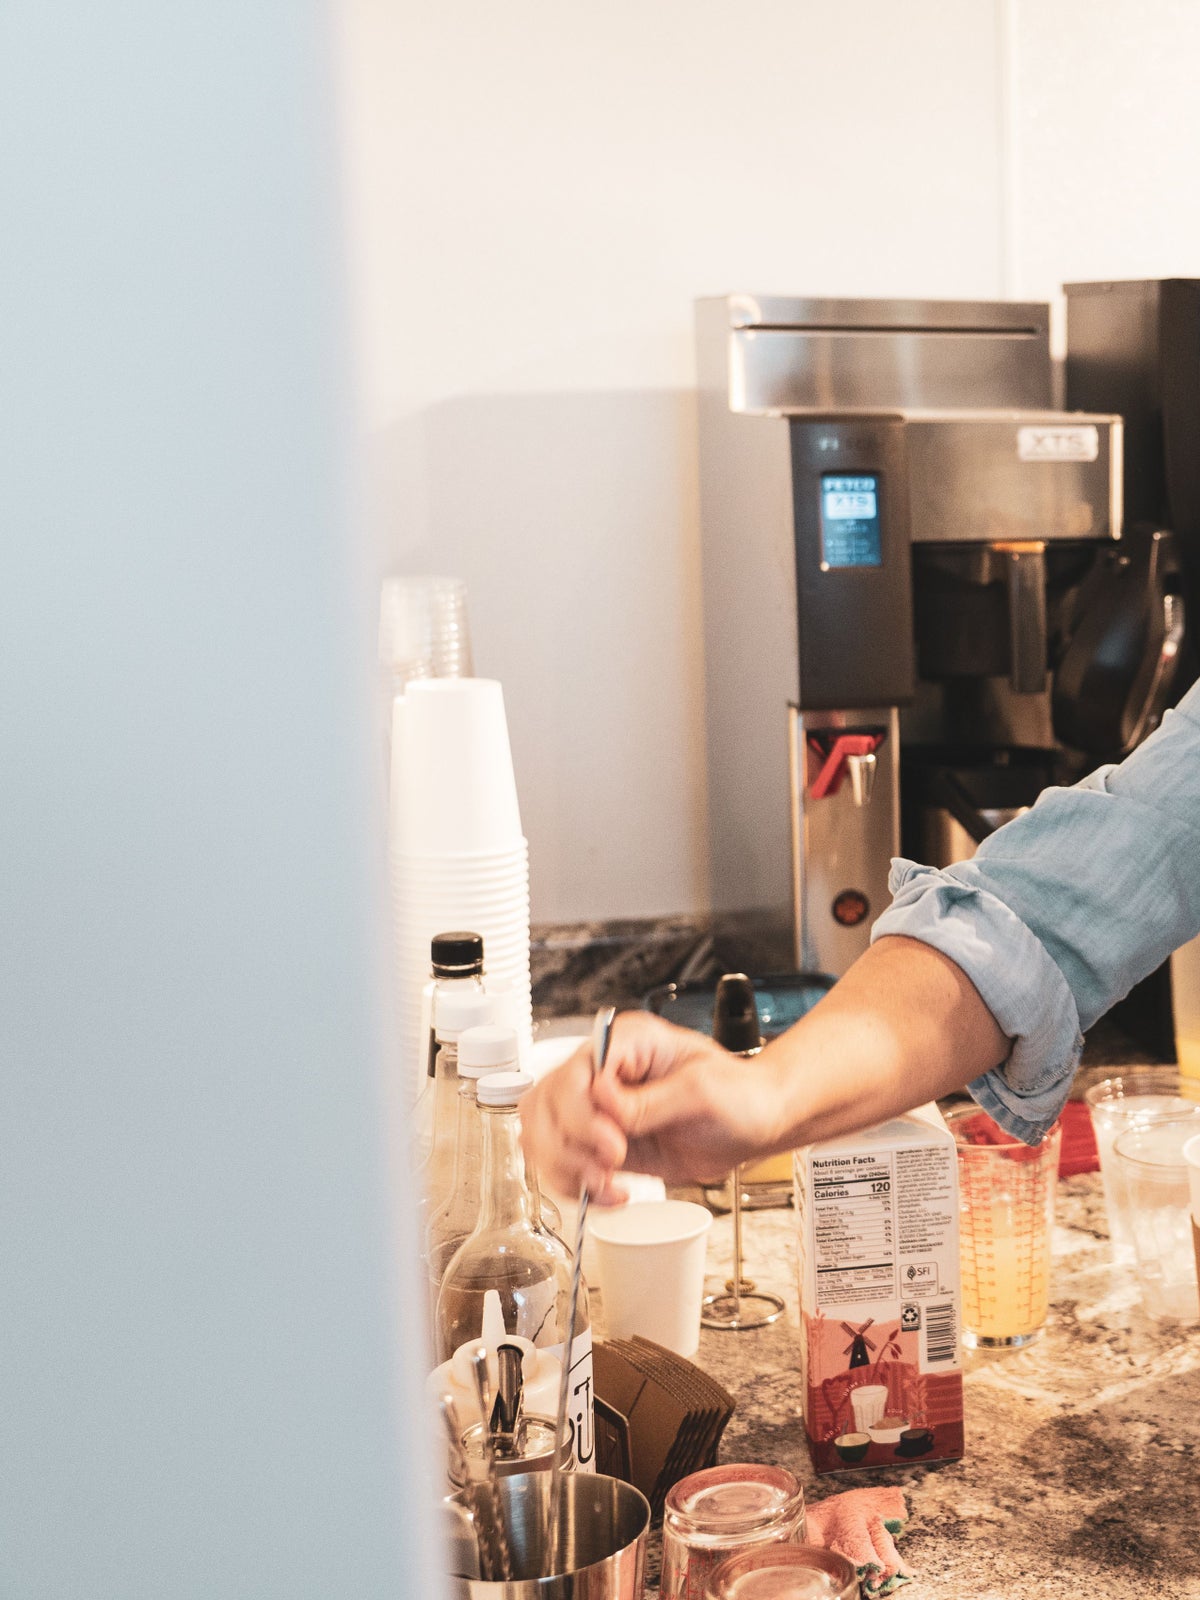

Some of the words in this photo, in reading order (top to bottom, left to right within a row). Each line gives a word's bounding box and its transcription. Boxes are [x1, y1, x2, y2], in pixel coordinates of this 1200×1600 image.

[812, 1159, 851, 1168] Nutrition
[852, 1156, 875, 1164] Facts
[814, 1189, 850, 1199] Calories
[870, 1181, 891, 1193] 120
[917, 1266, 930, 1276] SFI
